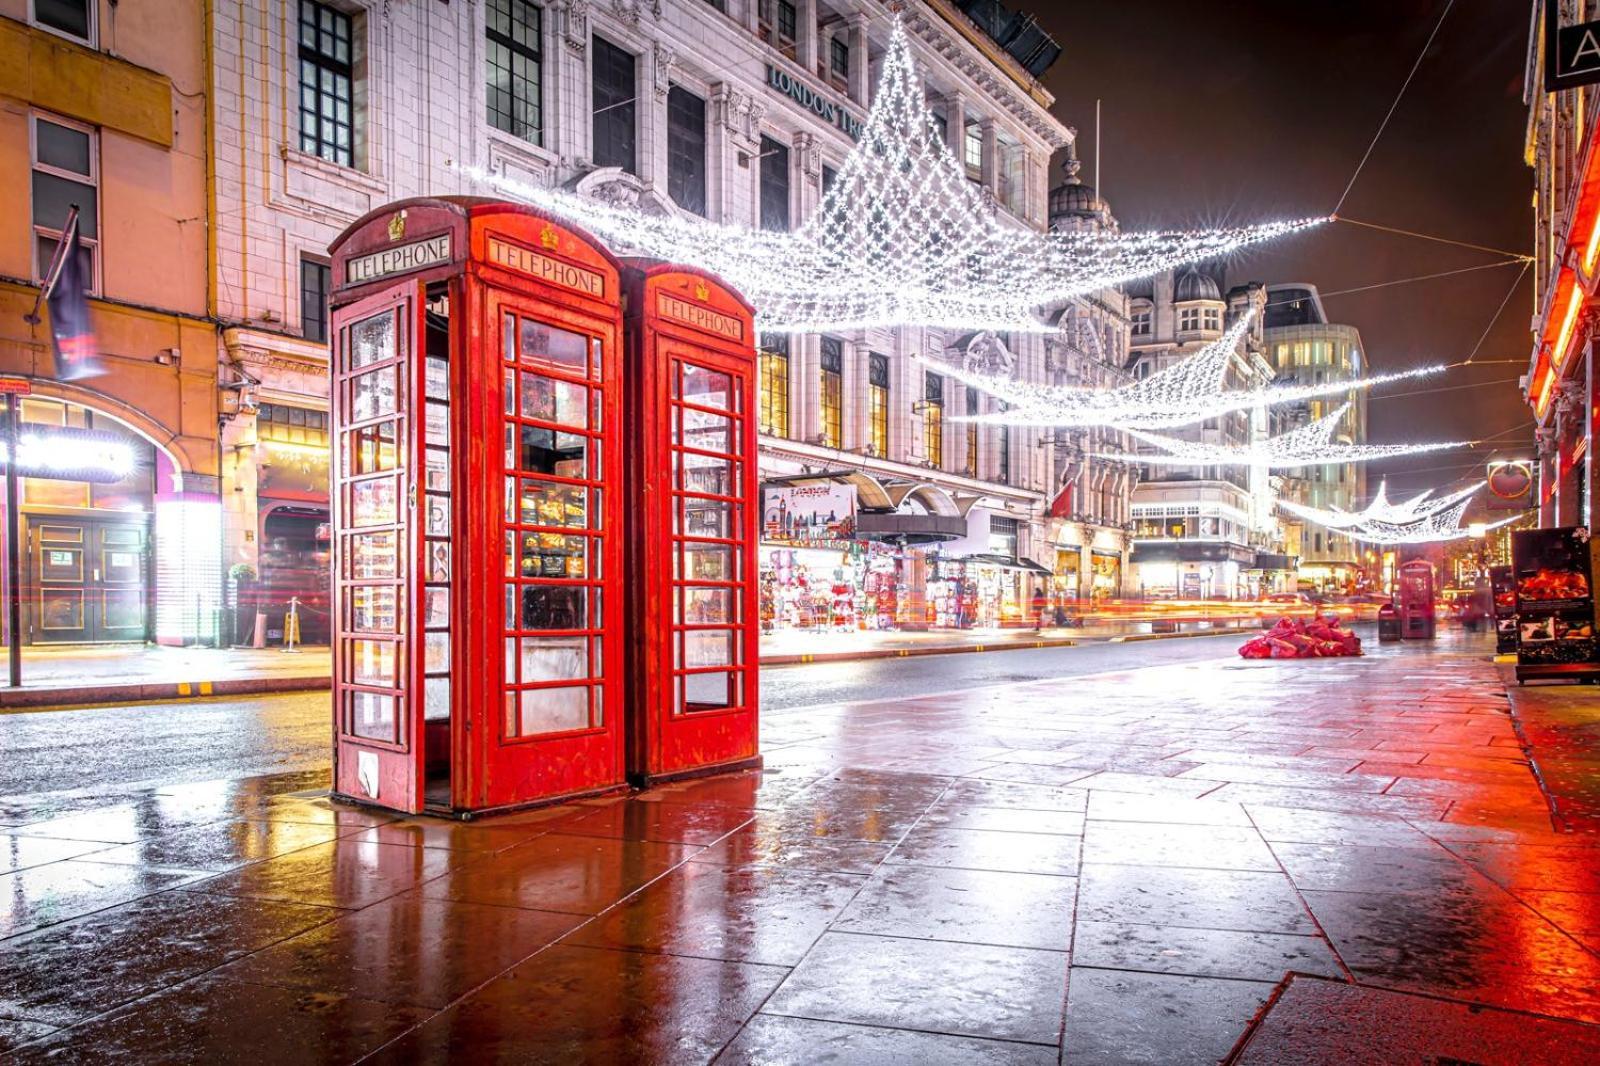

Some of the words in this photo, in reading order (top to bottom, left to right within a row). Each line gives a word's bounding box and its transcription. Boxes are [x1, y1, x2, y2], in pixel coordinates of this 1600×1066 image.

[771, 64, 834, 122] LONDON
[351, 237, 448, 281] TELEPHONE
[492, 241, 599, 294] TELEPHONE
[663, 298, 739, 337] TELEPHONE
